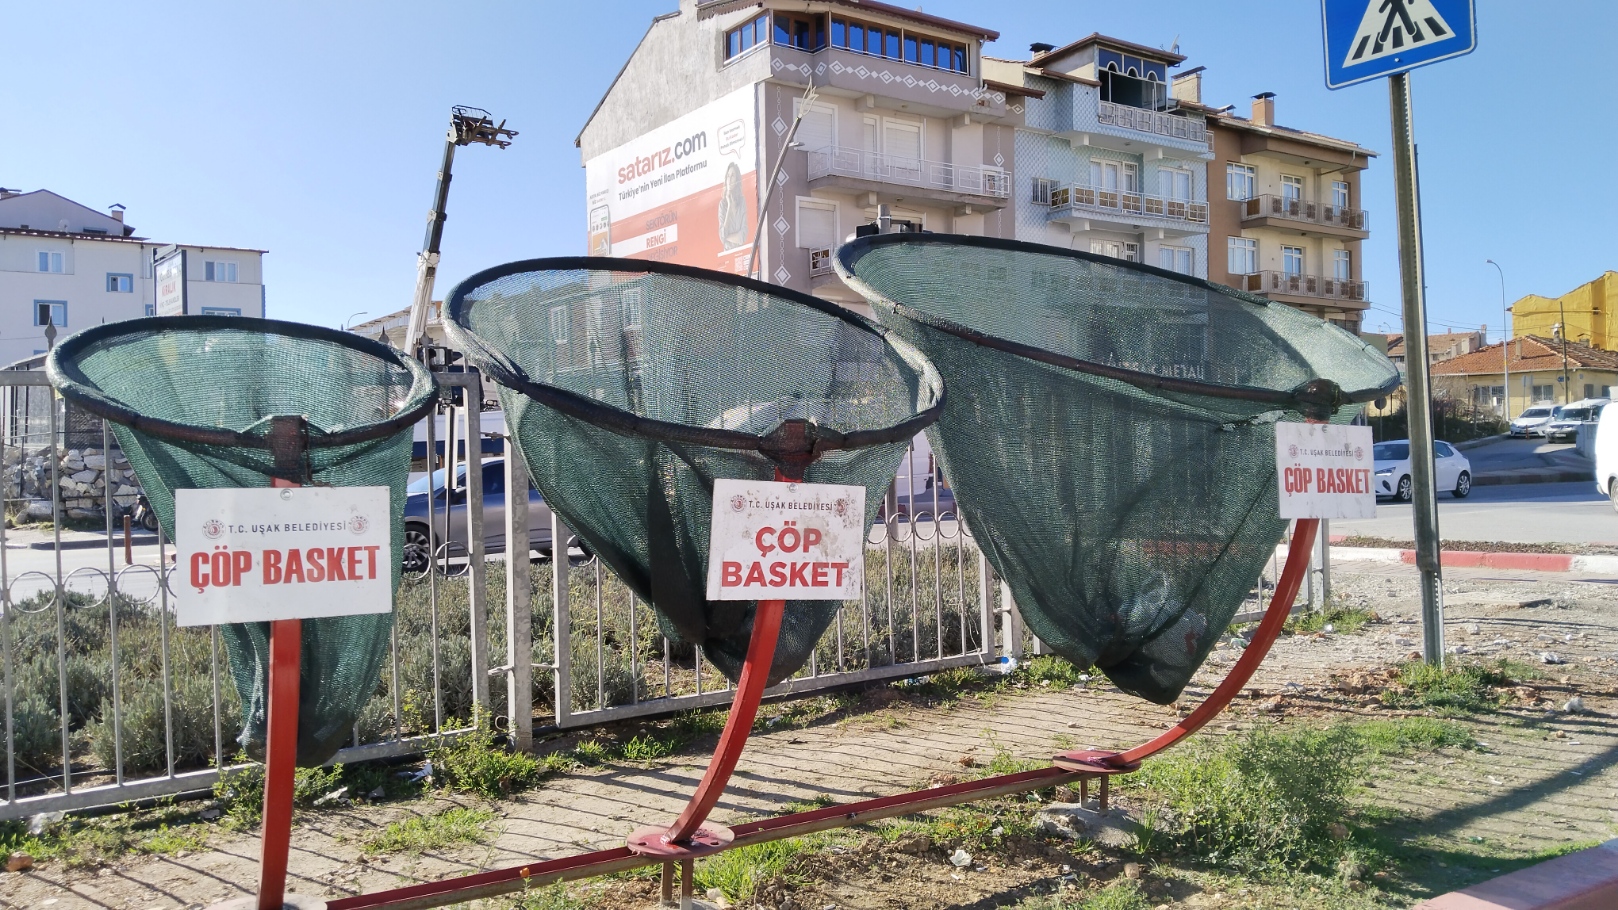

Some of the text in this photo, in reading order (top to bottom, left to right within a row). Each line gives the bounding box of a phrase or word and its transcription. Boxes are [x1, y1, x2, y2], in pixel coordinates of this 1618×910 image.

[618, 131, 707, 184] satarız.com
[618, 182, 649, 201] Türkiye'nin
[650, 175, 663, 188] Yeni
[664, 173, 675, 183] İlan
[676, 160, 707, 179] Platformu
[646, 210, 678, 230] SEKTÖRÜN
[646, 229, 667, 248] RENGİ
[1310, 449, 1324, 457] UŞAK
[1325, 449, 1354, 457] BELEDİYESİ
[1284, 463, 1370, 497] ÇÖP BASKET
[765, 501, 786, 511] UŞAK
[788, 502, 833, 511] BELEDİYESİ
[228, 525, 248, 534] T.C.
[251, 523, 280, 535] UŞAK
[284, 521, 346, 531] BELEDİYESİ
[755, 520, 822, 558] ÇÖP
[190, 545, 380, 594] ÇÖP BASKET
[721, 561, 849, 588] BASKET
